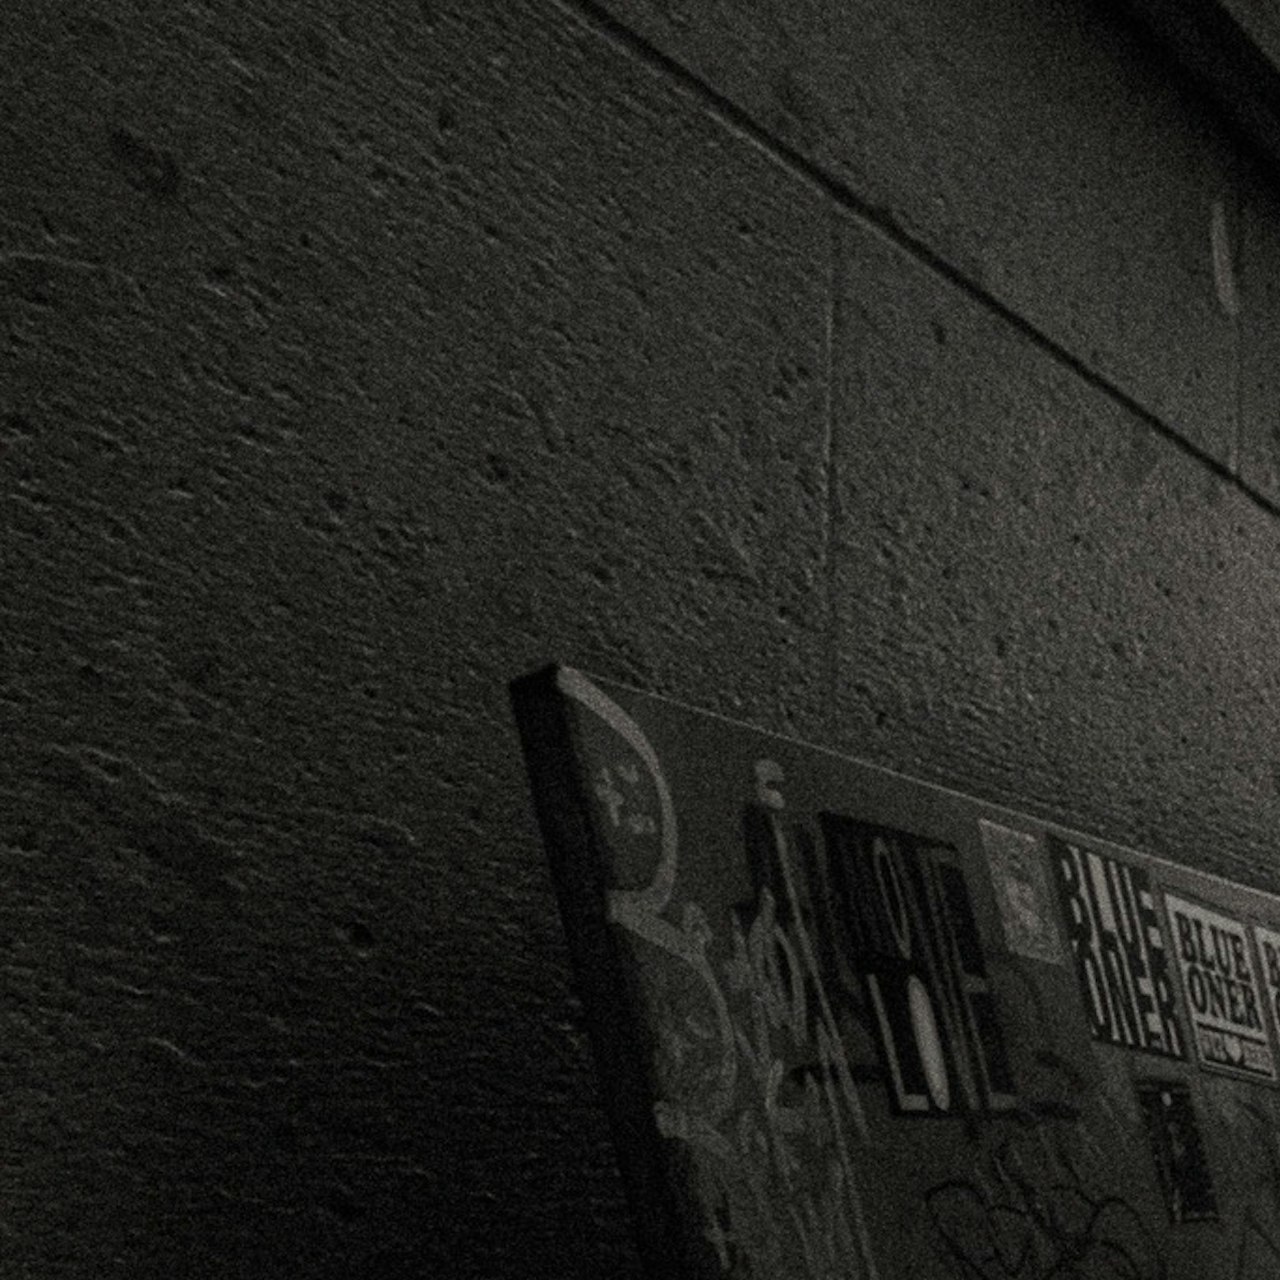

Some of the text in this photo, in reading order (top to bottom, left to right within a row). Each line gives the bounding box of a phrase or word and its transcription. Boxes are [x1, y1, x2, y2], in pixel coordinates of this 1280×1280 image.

[1049, 834, 1166, 962] BLUE
[1174, 910, 1251, 981] BLUE
[1072, 941, 1188, 1060] ONER
[1187, 964, 1265, 1032] ONER
